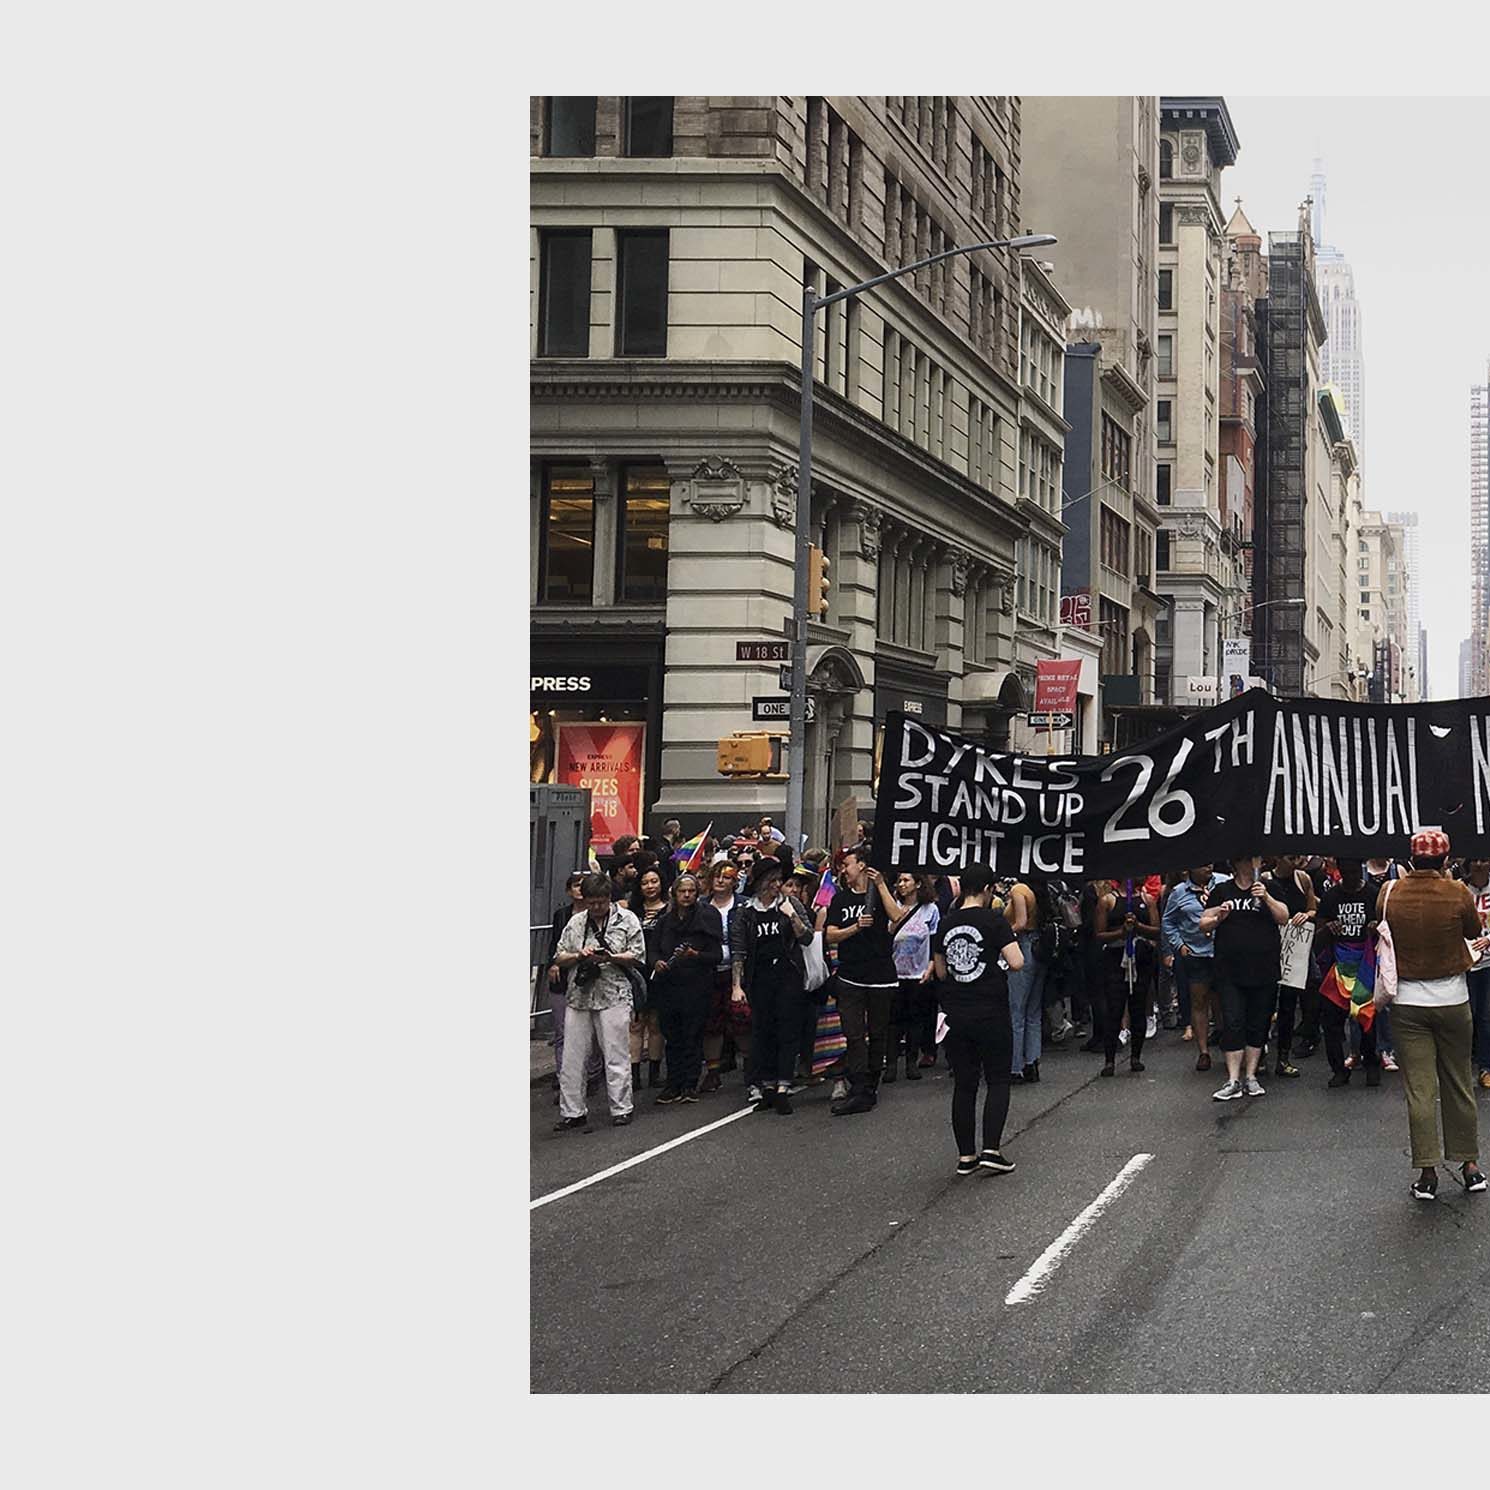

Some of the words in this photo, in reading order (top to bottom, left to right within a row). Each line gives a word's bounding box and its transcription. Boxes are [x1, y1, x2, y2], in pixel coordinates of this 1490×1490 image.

[741, 647, 751, 658] W
[756, 647, 768, 658] 18
[772, 647, 784, 658] St
[530, 676, 592, 691] PRESS
[1190, 682, 1212, 692] Lou
[763, 704, 785, 714] ONE
[900, 720, 1079, 790] DYKES
[568, 762, 586, 772] NEW
[1264, 710, 1442, 835] ANNUAL
[579, 779, 618, 796] SIZES
[893, 773, 1026, 824] STAND
[1039, 793, 1084, 828] UP
[891, 822, 1005, 873] FIGHT
[1020, 832, 1085, 873] ICE
[1338, 902, 1365, 914] VOTE
[1337, 914, 1366, 925] THEM
[1341, 924, 1362, 936] OUT
